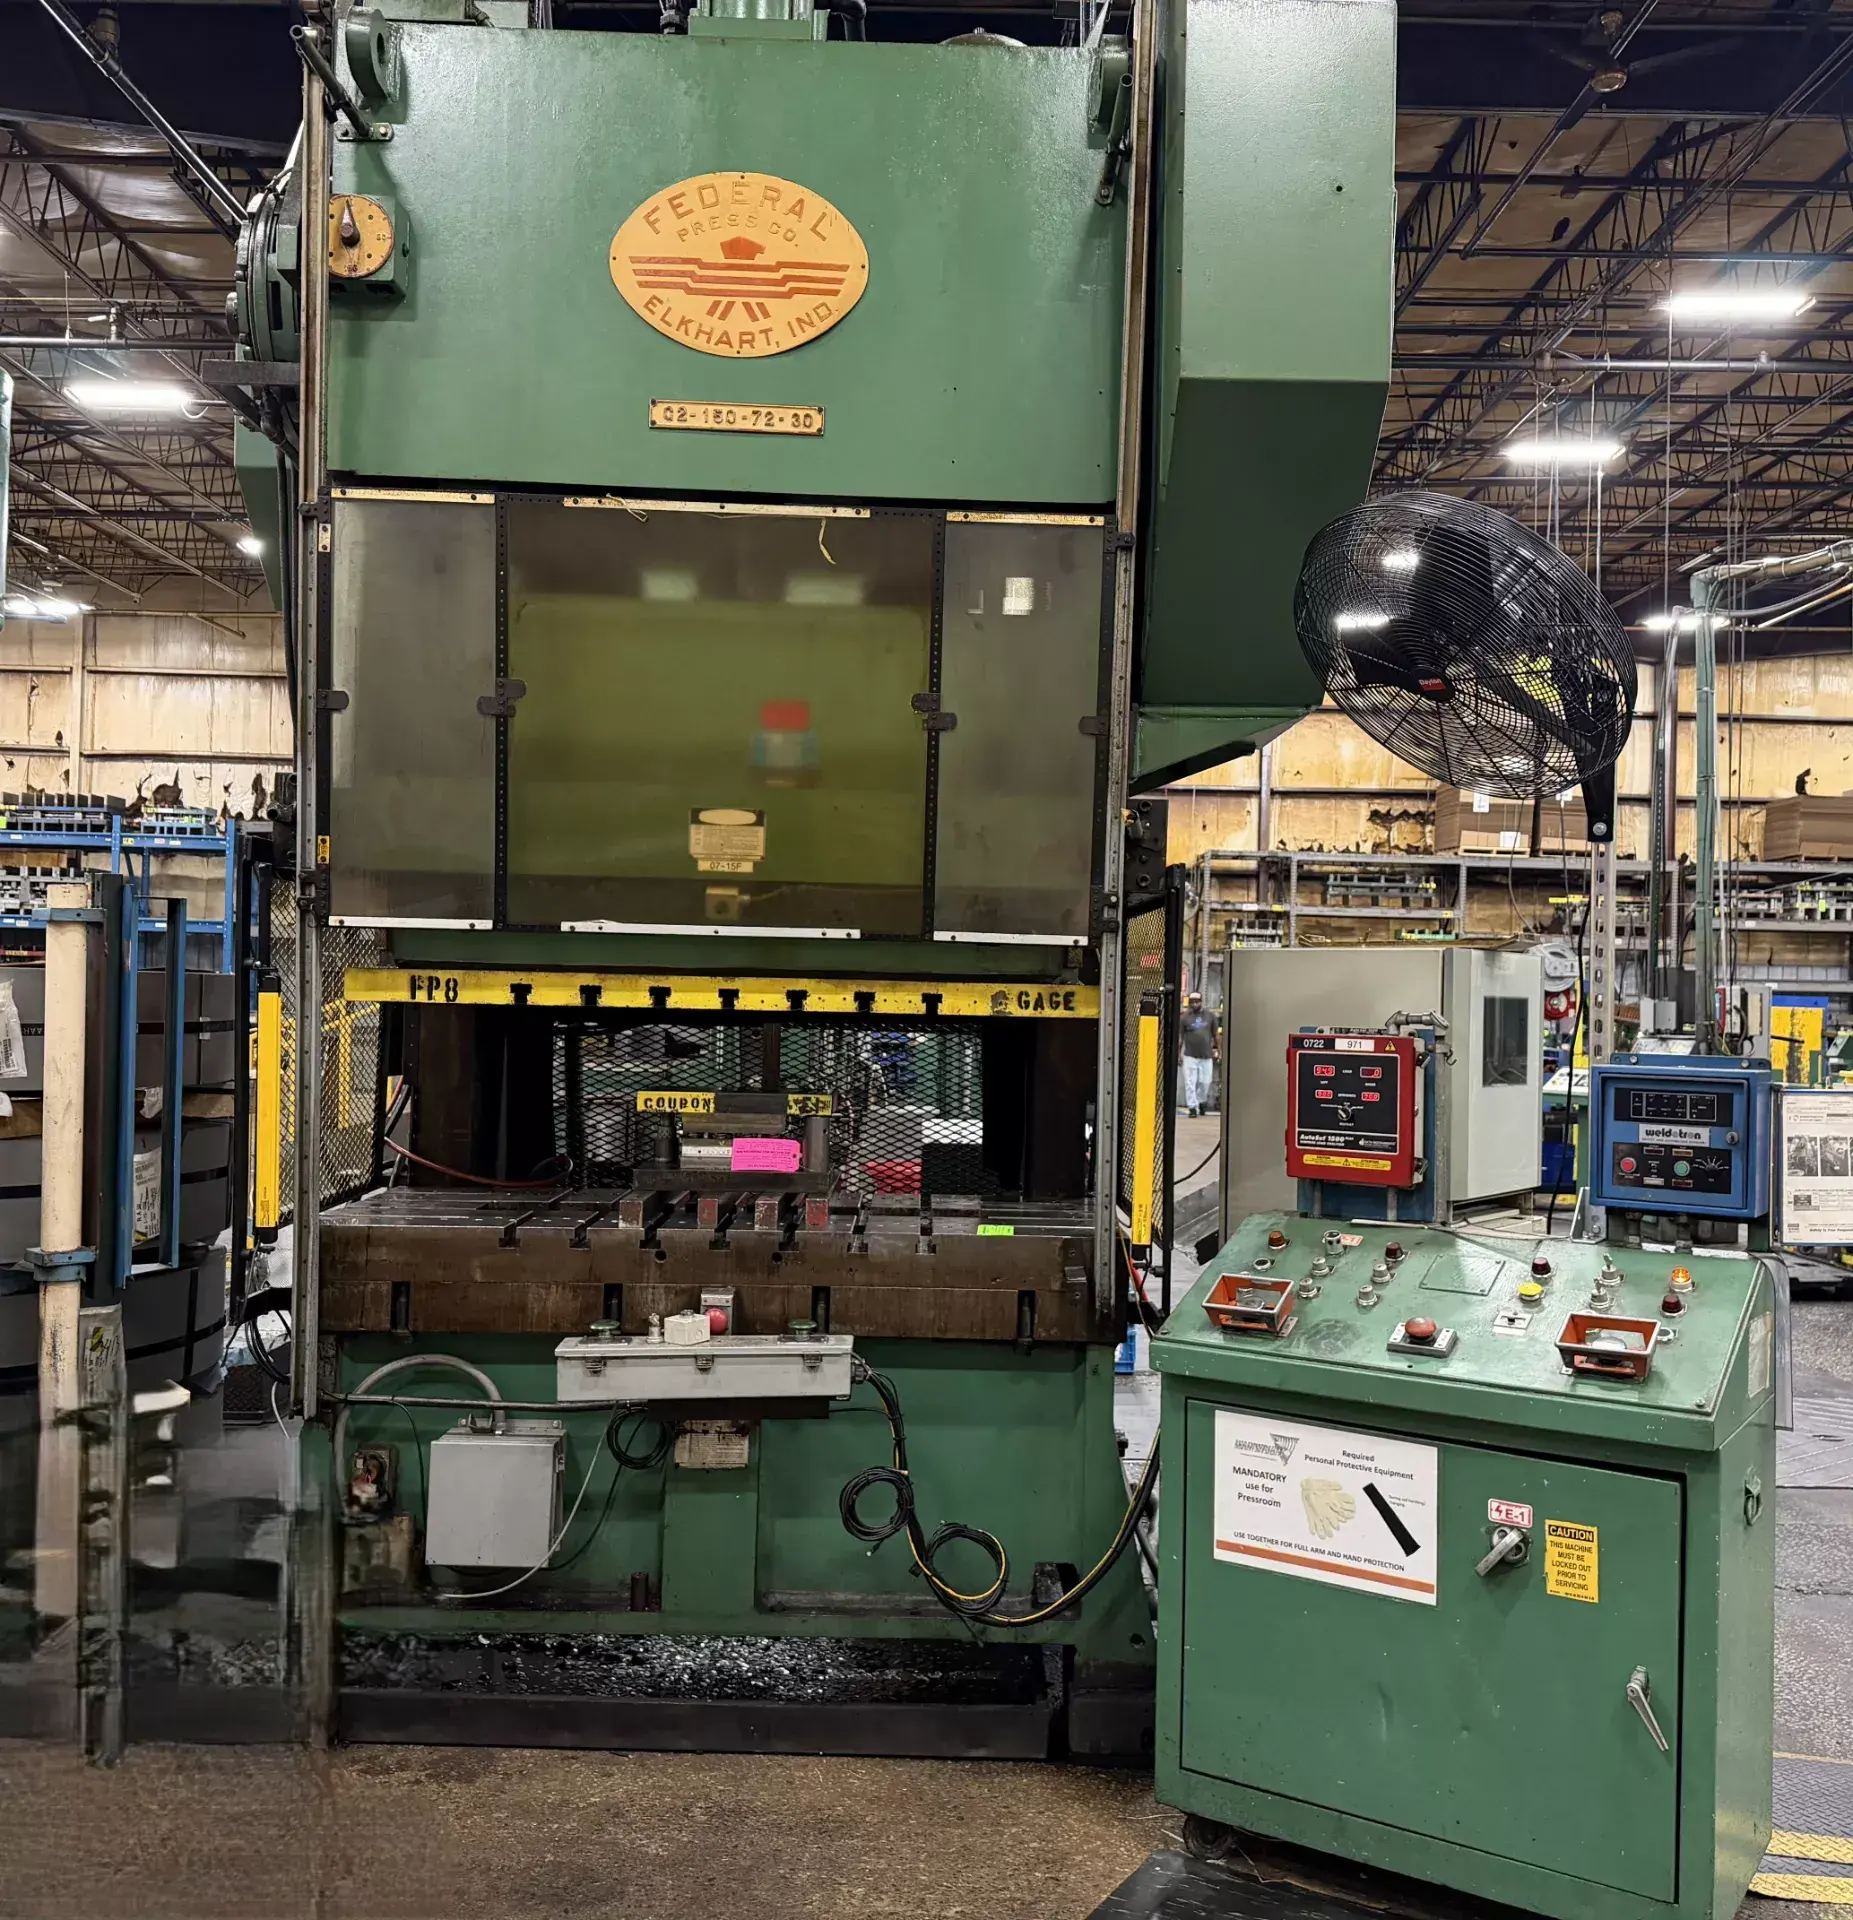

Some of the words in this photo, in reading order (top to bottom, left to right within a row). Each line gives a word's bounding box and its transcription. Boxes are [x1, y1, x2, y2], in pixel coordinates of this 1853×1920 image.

[642, 181, 827, 242] FEDERAL
[676, 213, 758, 242] PRESS
[768, 221, 799, 247] CO.
[643, 294, 780, 350] ELKHART,
[710, 861, 742, 871] 07-15F
[1017, 990, 1075, 1011] GAGE
[1304, 1039, 1324, 1048] 0722
[1347, 1040, 1362, 1048] 971
[644, 1096, 712, 1112] COUPON
[1342, 1450, 1374, 1462] Required
[1304, 1454, 1334, 1466] Personal
[1336, 1460, 1372, 1472] Protective
[1374, 1467, 1414, 1480] Equipment
[1232, 1466, 1287, 1483] MANDATORY
[1262, 1484, 1274, 1493] for
[1238, 1492, 1281, 1508] Pressroom
[1550, 1526, 1593, 1541] CAUTION
[1247, 1534, 1279, 1545] TOGETHER
[1343, 1554, 1362, 1562] HAND
[1364, 1558, 1404, 1571] PROTECTION
[1550, 1540, 1563, 1549] THIS
[1565, 1543, 1593, 1553] MACHINE
[1558, 1552, 1574, 1560] MUST
[1552, 1560, 1577, 1570] LOCKED
[1557, 1570, 1576, 1579] PRIOR
[1555, 1579, 1588, 1590] SERVICING
